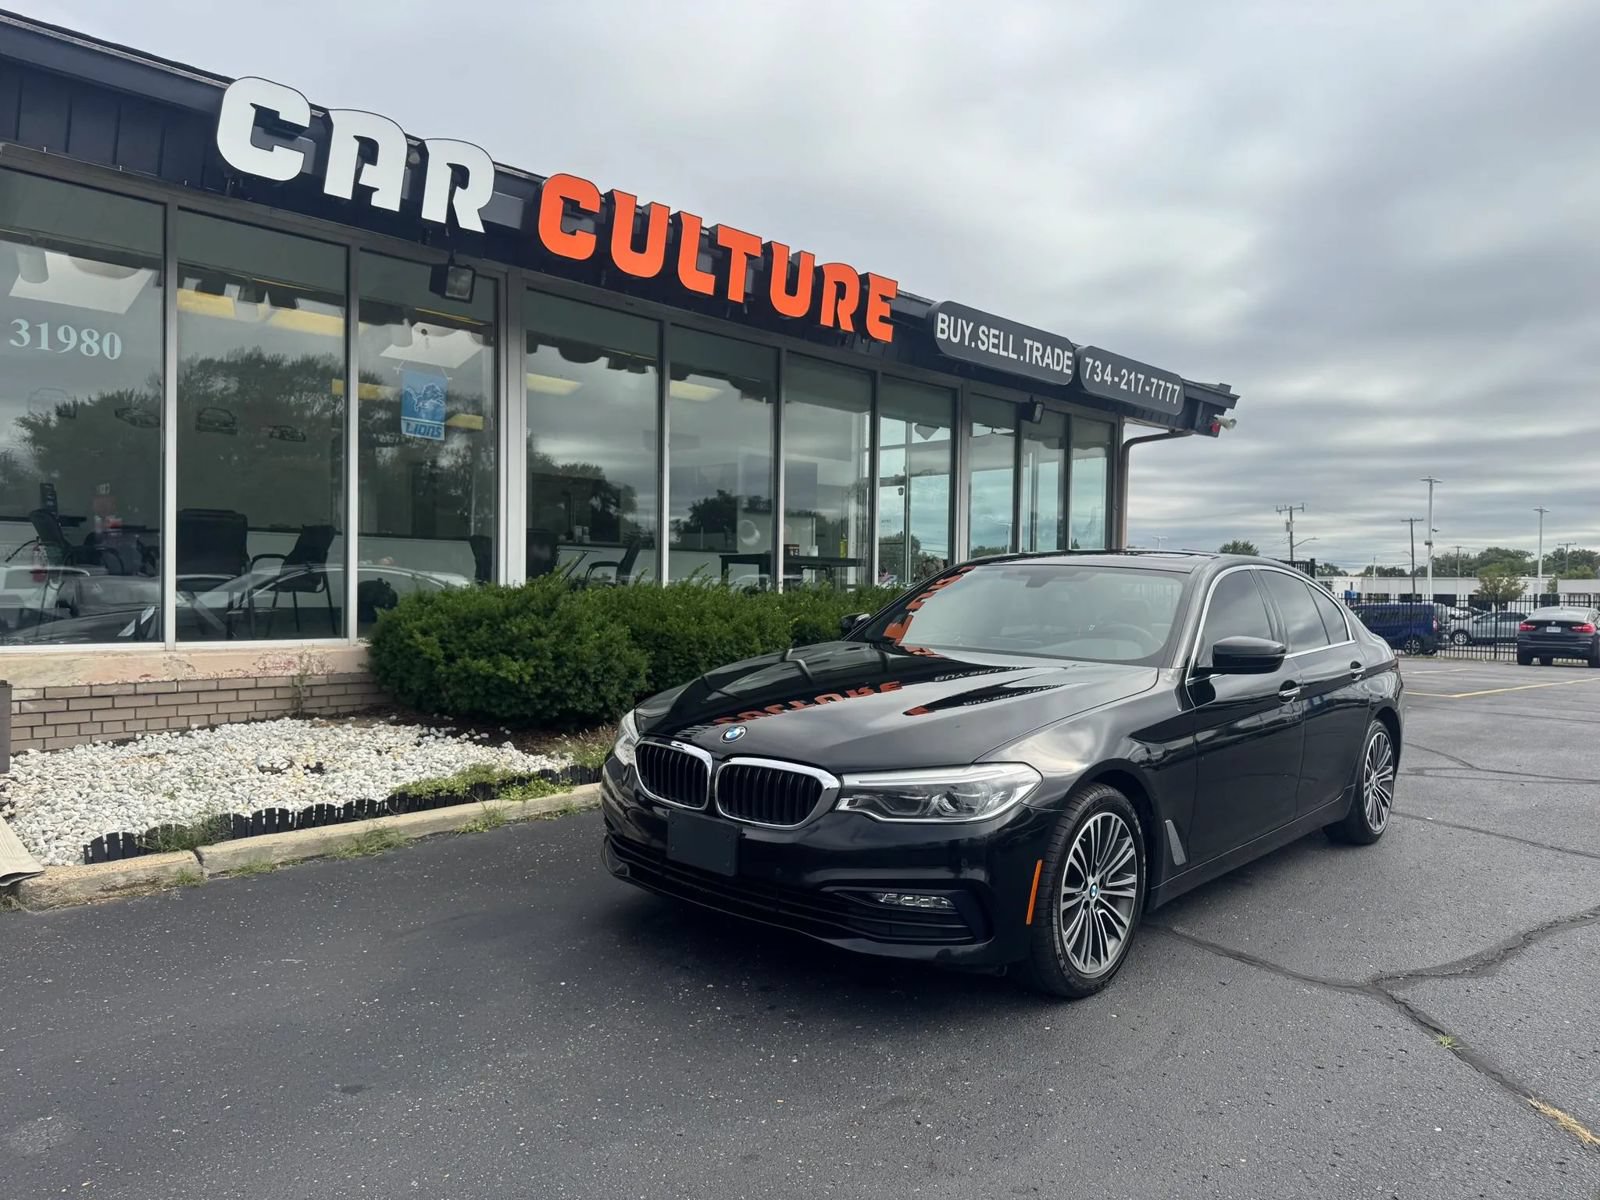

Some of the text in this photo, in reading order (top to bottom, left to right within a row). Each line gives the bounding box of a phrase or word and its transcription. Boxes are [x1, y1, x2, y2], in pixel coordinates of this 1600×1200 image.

[217, 76, 898, 342] CAR CULTURE
[9, 318, 122, 360] 31980
[1085, 357, 1180, 404] 734-217-7777
